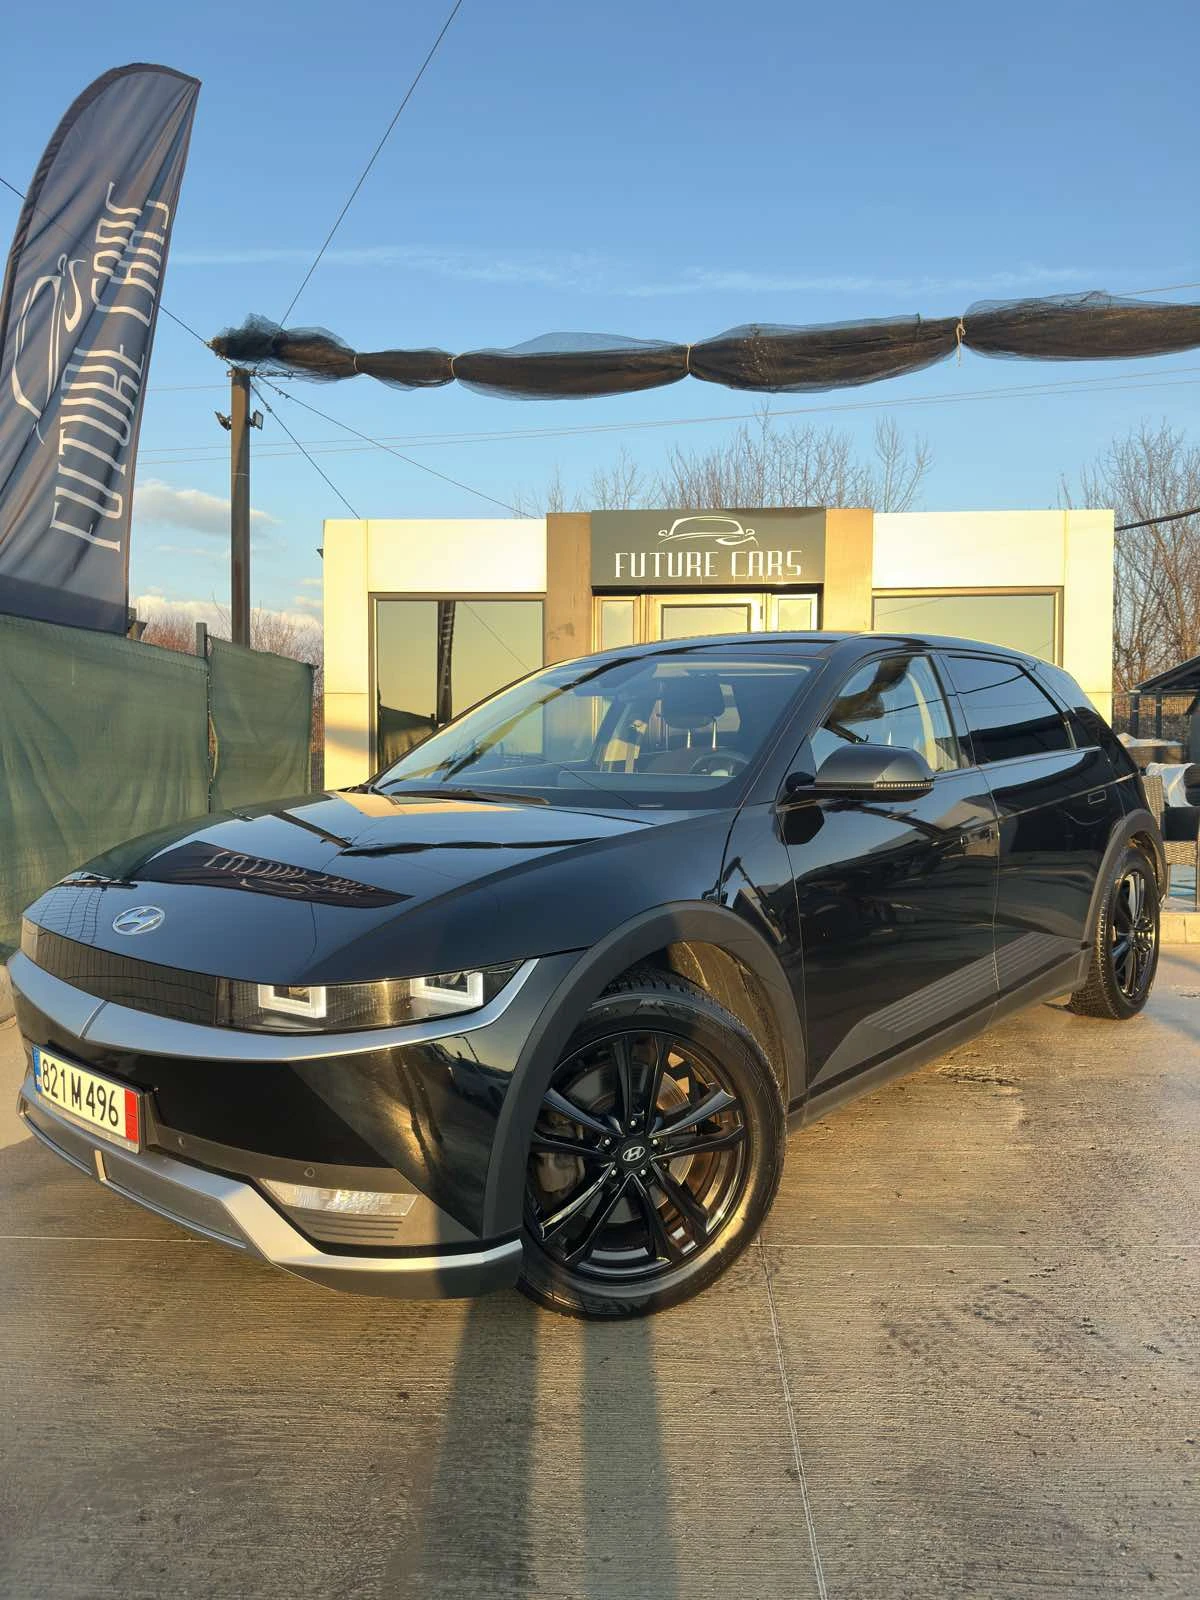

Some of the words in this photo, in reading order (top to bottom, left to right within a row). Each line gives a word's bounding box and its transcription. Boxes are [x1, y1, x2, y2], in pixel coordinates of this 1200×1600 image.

[91, 182, 169, 328] CARS
[50, 344, 144, 553] FUTURE
[615, 551, 719, 578] FUTURE
[731, 550, 802, 577] CARS
[42, 1059, 66, 1103] 821
[71, 1072, 82, 1111] M
[86, 1081, 119, 1127] 496
